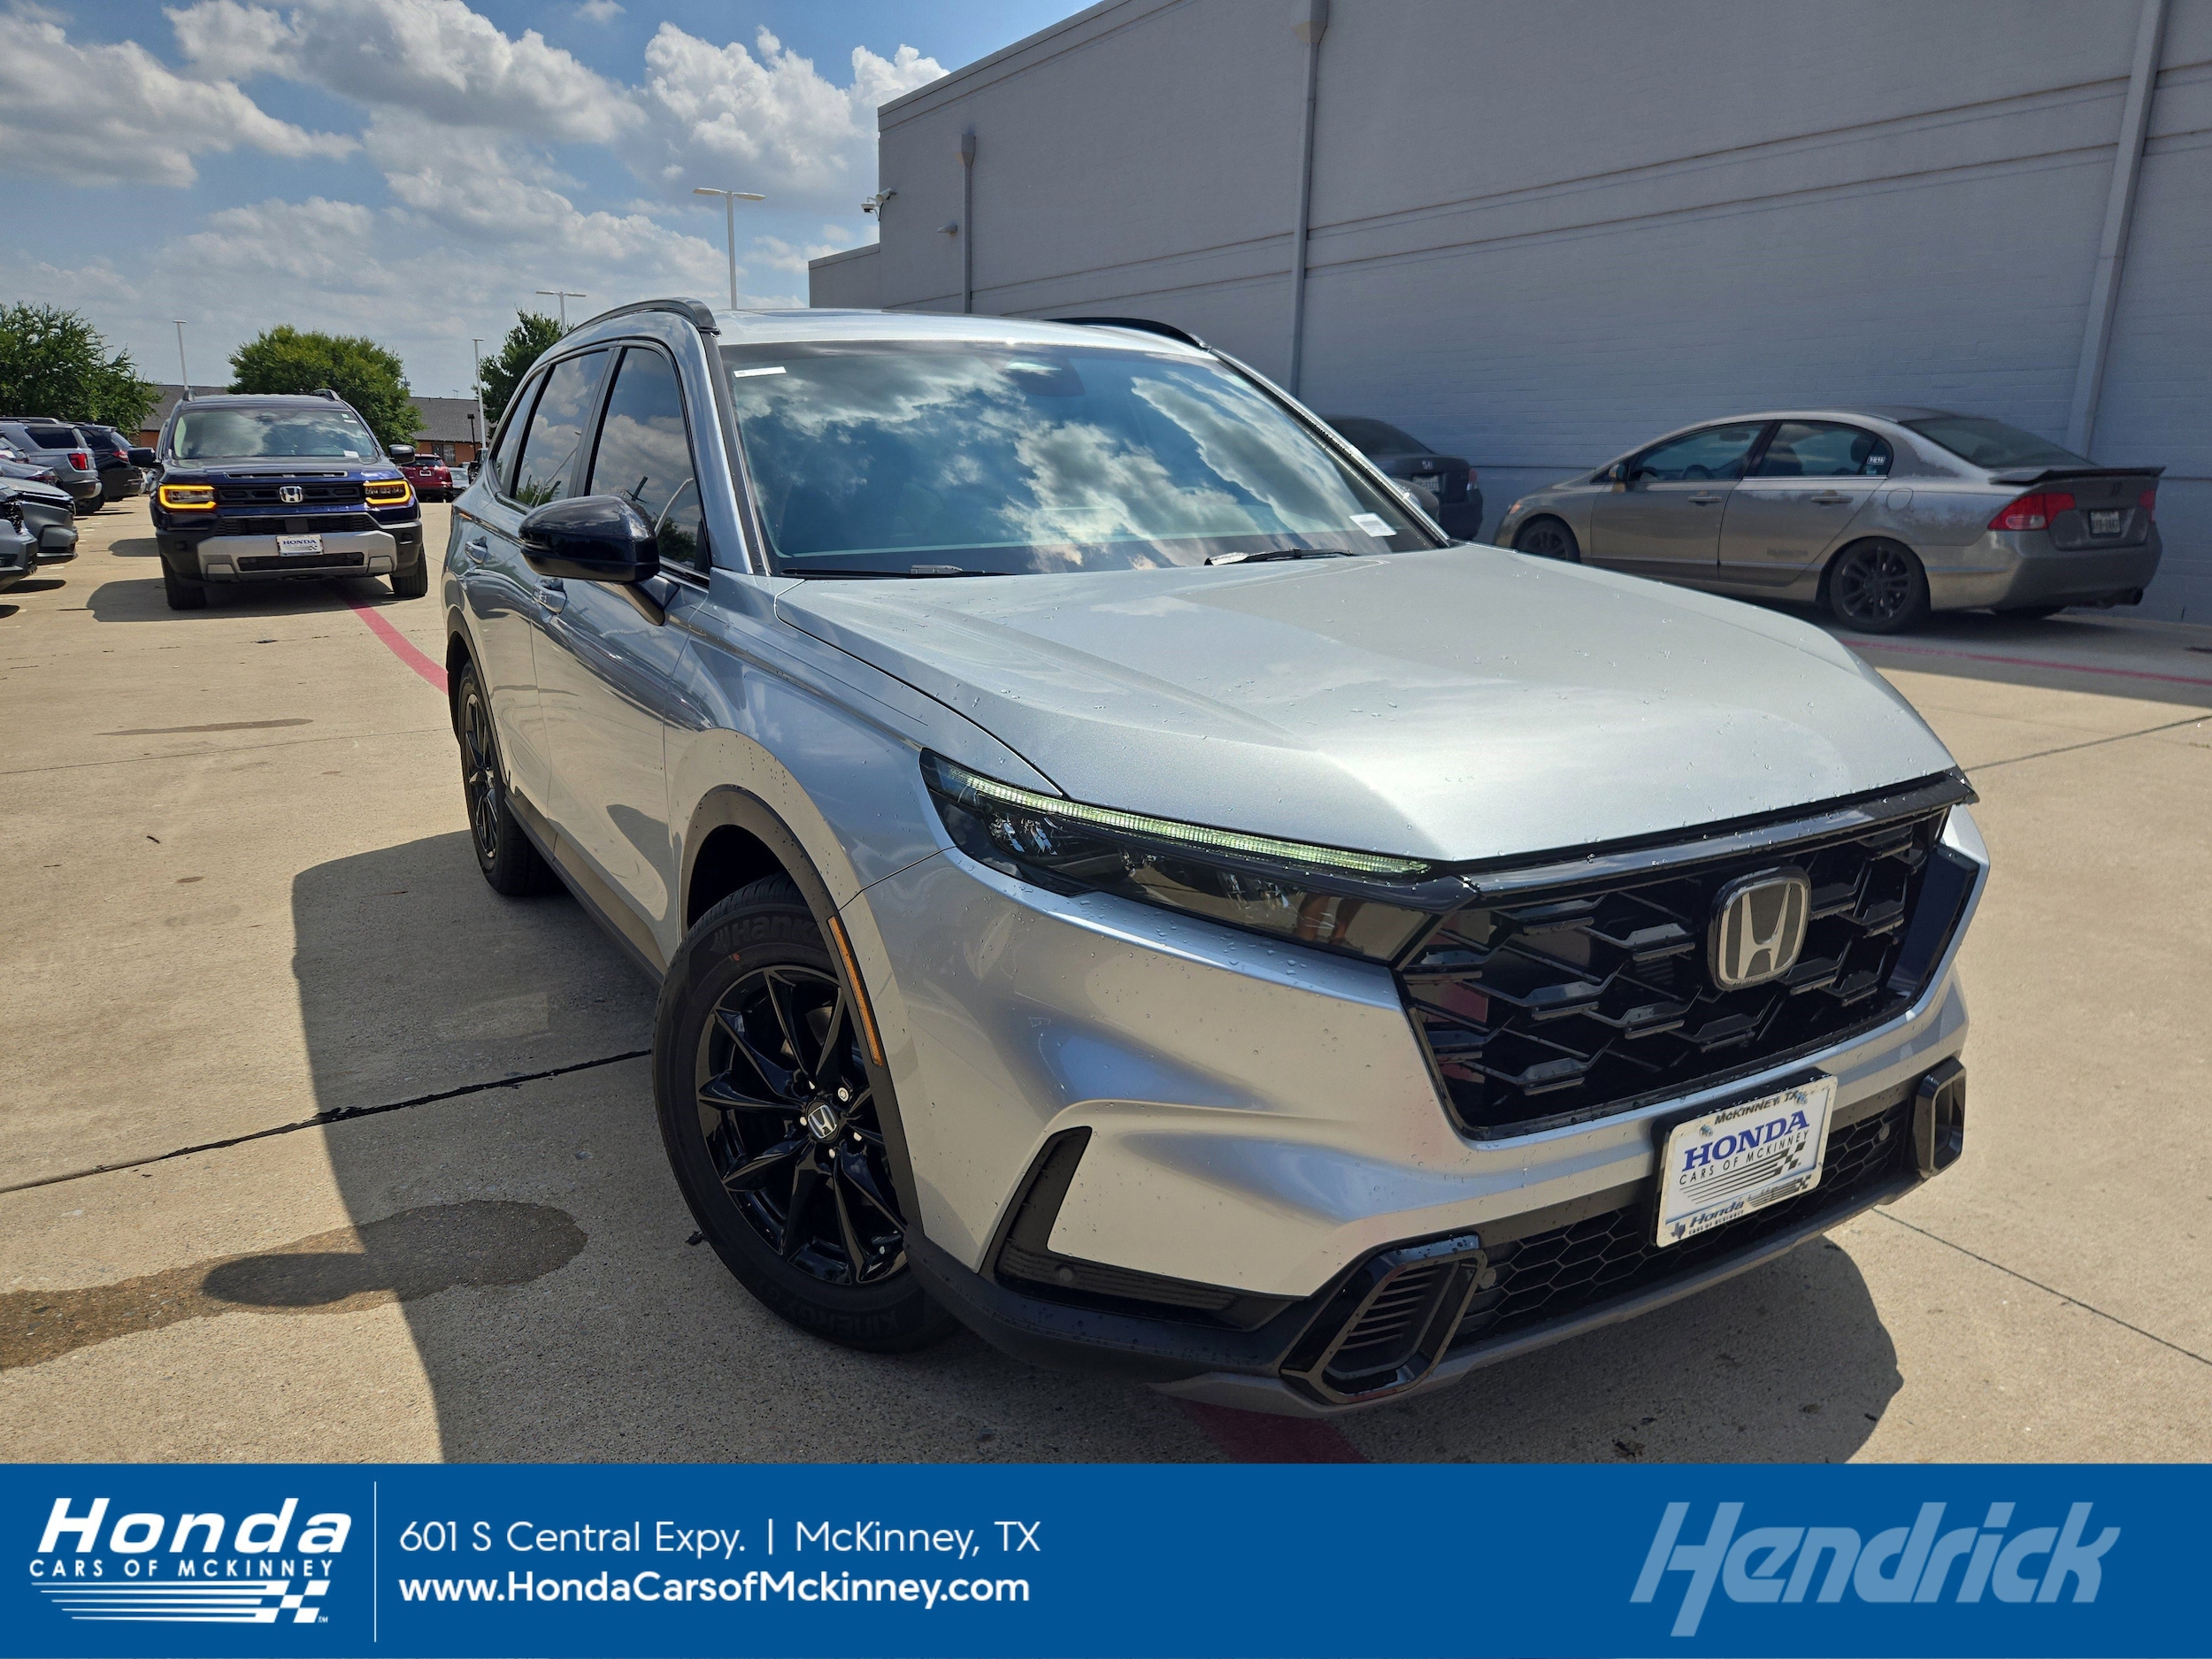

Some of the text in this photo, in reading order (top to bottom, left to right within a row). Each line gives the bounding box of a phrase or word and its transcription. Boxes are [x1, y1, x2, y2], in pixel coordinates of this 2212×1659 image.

[1678, 1129, 1809, 1186] CARS OF MCKINNEY
[1681, 1110, 1810, 1172] HONDA
[1689, 1201, 1744, 1227] Honda
